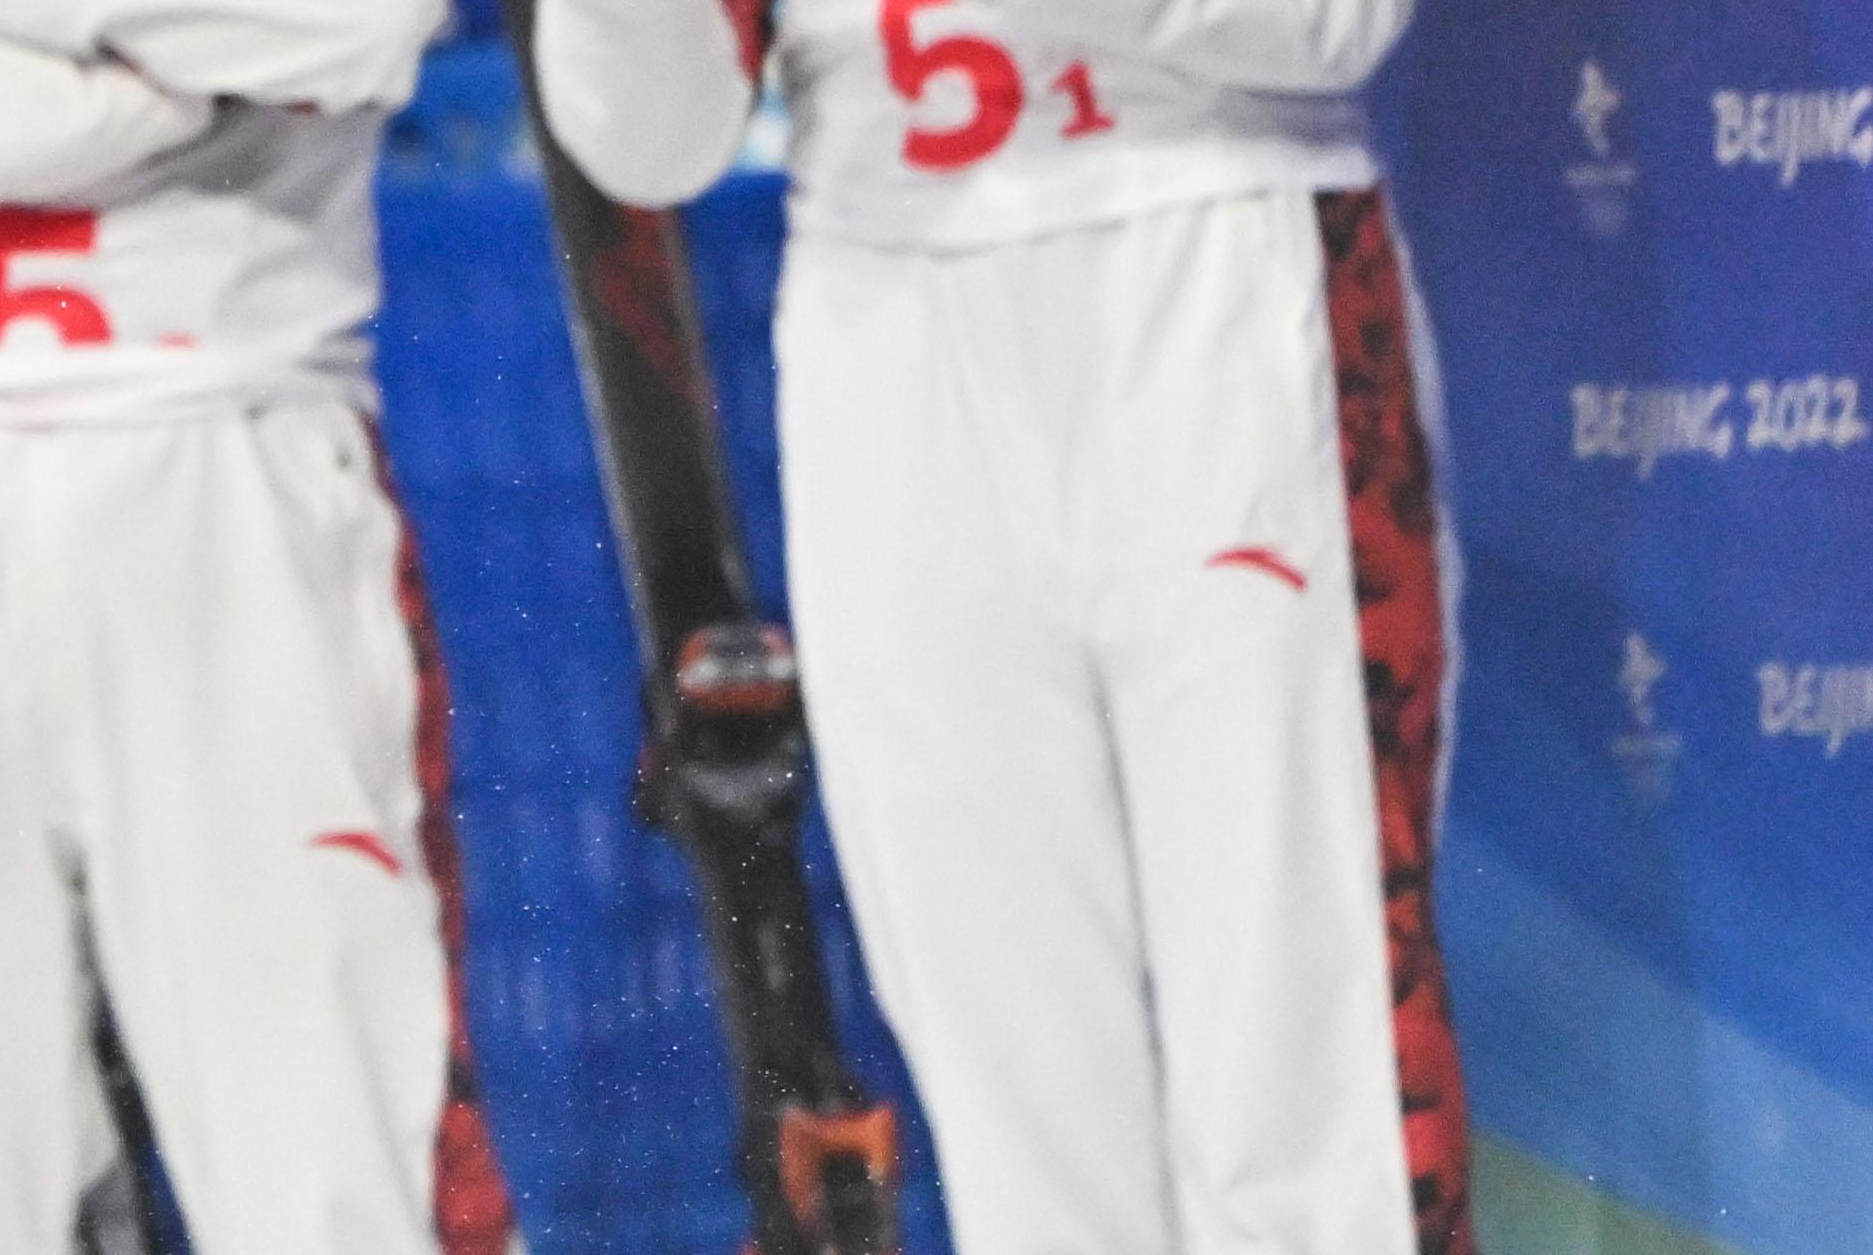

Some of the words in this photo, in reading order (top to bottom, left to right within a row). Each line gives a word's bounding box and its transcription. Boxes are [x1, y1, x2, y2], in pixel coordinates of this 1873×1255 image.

[1050, 60, 1116, 139] 1
[1572, 382, 1731, 482] BEIJING
[1748, 374, 1868, 453] 2022
